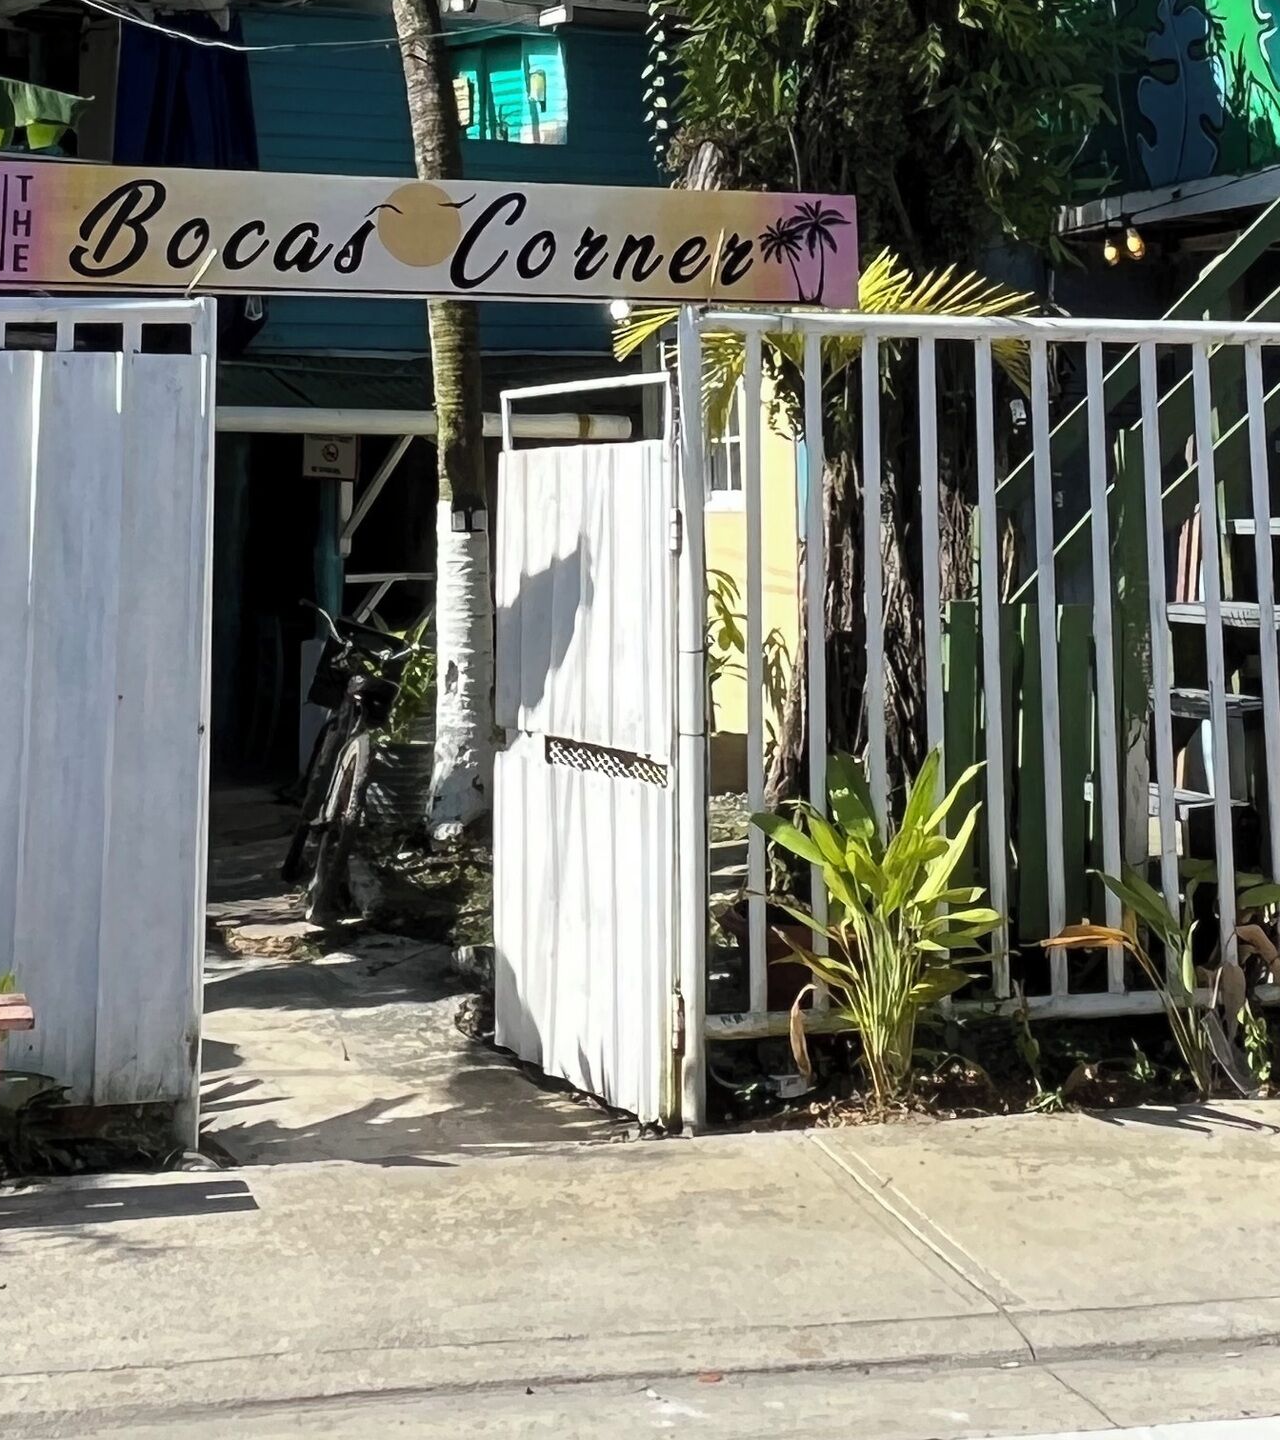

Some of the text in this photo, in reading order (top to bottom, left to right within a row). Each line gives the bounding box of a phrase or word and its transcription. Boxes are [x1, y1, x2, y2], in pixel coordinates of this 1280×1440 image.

[12, 175, 34, 273] THE
[69, 178, 754, 290] Bocas Corner
